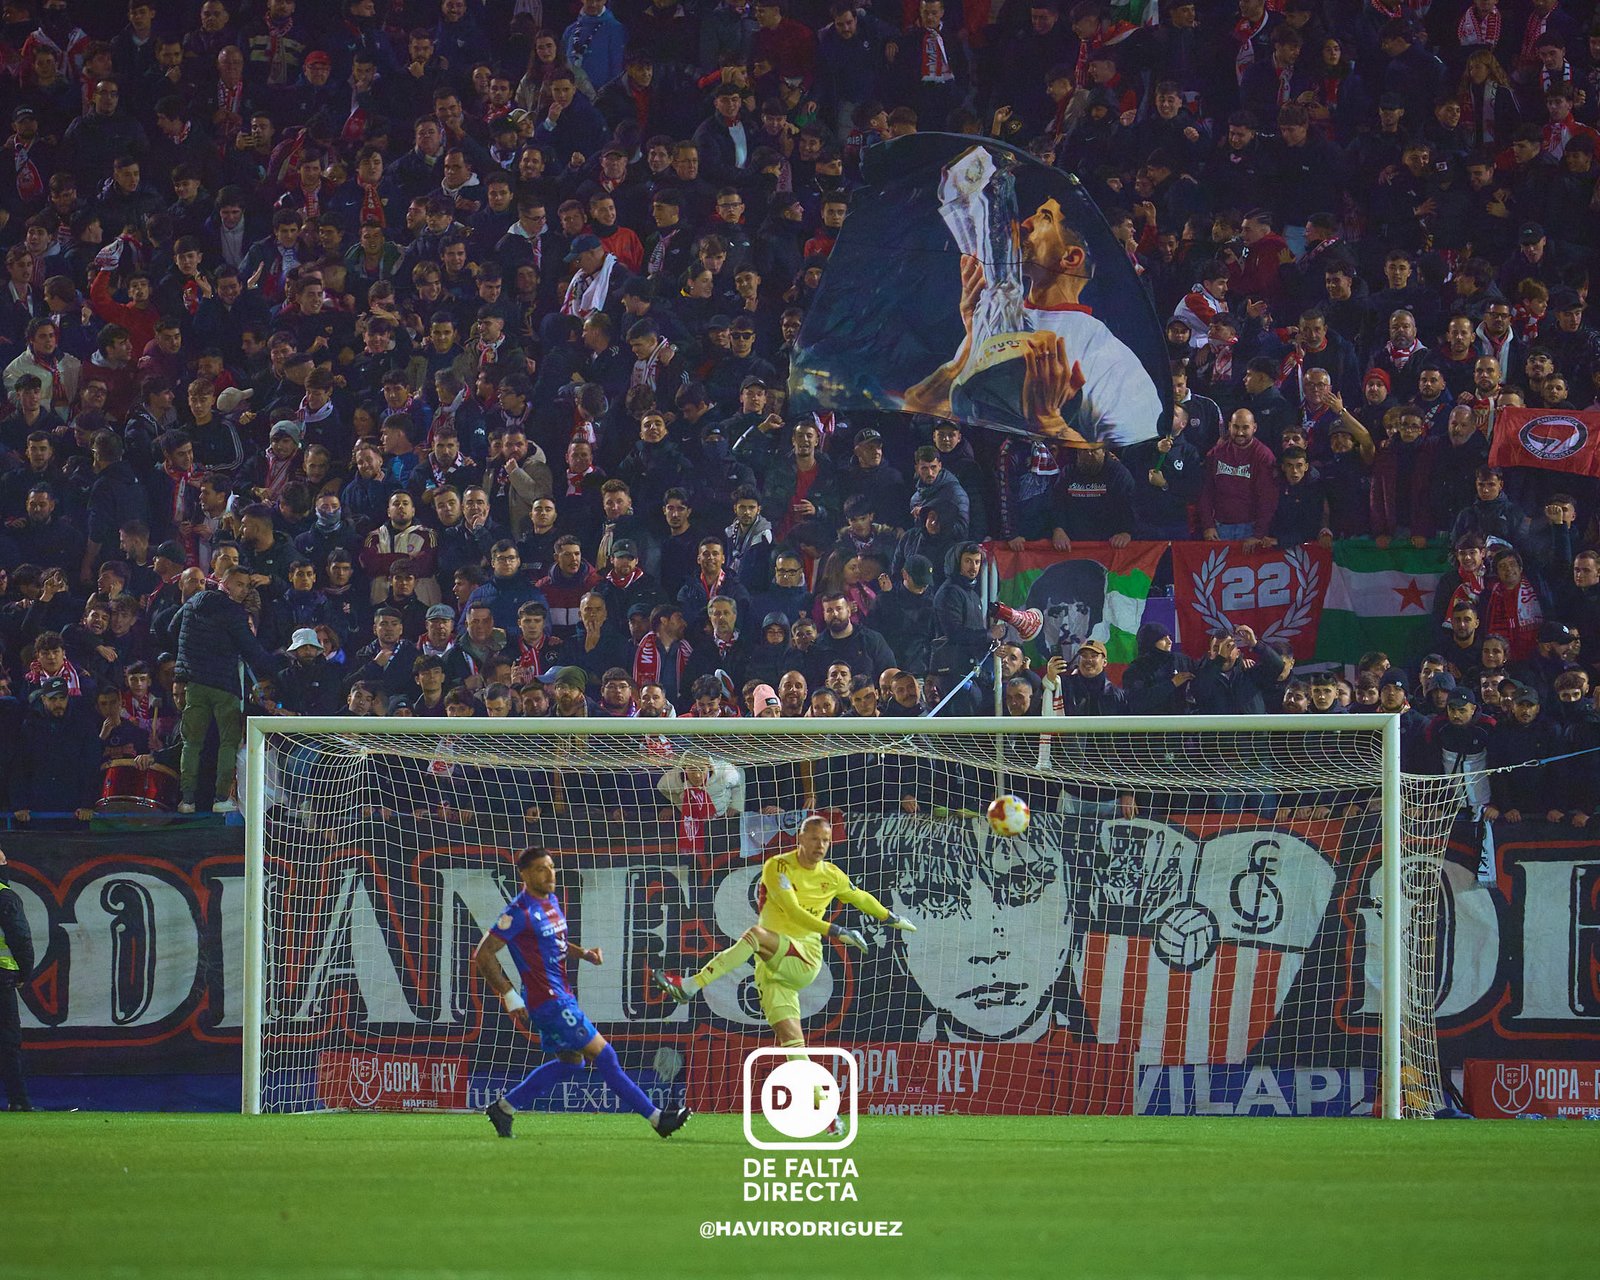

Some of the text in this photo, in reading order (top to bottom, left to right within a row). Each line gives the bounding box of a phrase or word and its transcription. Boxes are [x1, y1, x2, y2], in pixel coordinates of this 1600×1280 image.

[1222, 562, 1291, 611] 22
[561, 1008, 577, 1027] 8
[384, 1061, 420, 1093] COPA
[431, 1062, 457, 1093] REY
[937, 1049, 985, 1093] REY
[1535, 1068, 1579, 1100] COPA
